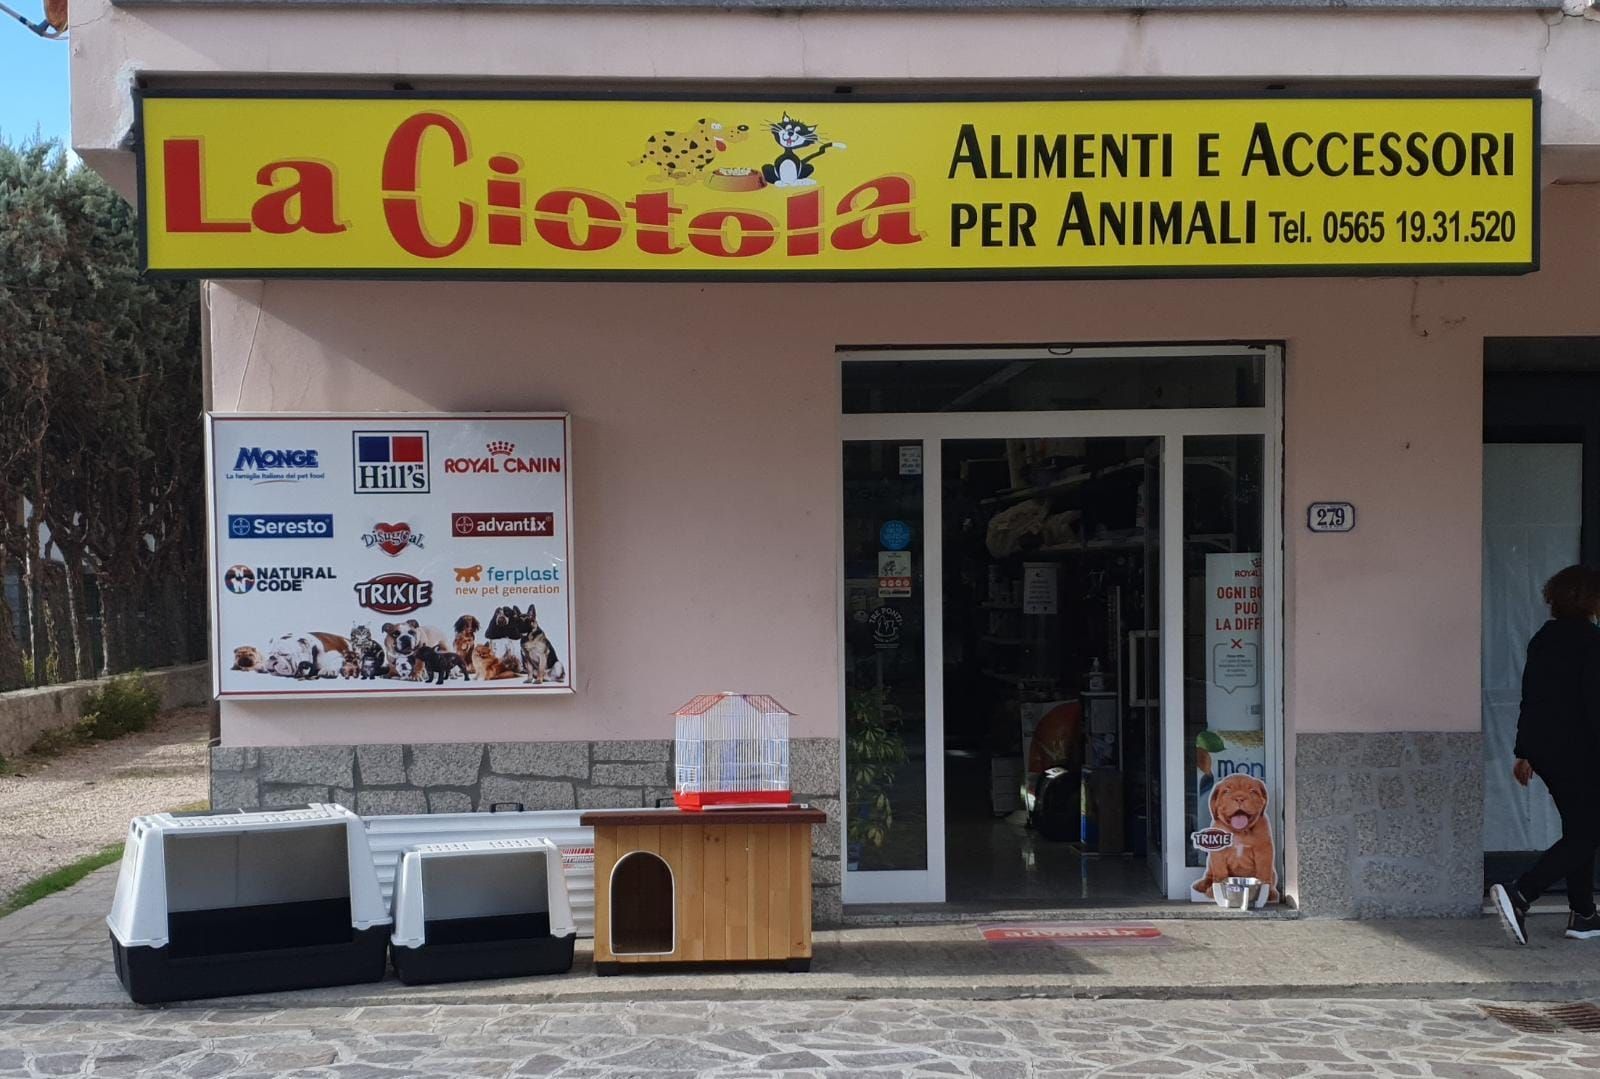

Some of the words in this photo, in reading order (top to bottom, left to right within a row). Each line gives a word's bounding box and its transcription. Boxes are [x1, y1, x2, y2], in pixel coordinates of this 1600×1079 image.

[948, 123, 1173, 179] ALIMENTI
[1198, 132, 1220, 177] E
[1241, 122, 1515, 178] ACCESSORI
[163, 135, 353, 233] La
[381, 110, 927, 259] Ciotola
[951, 202, 1037, 248] PER
[1056, 191, 1256, 247] ANIMALI
[1268, 212, 1312, 244] Tel.
[1322, 211, 1385, 243] 0565
[1395, 210, 1516, 243] 19.31.520
[233, 447, 320, 470] MONGE
[444, 458, 497, 474] ROYAL
[503, 457, 561, 473] CANIN
[359, 464, 426, 489] Hill's
[477, 516, 547, 533] advantix
[1317, 508, 1346, 526] 279
[254, 518, 328, 535] Seresto
[257, 567, 337, 580] NATURAL
[486, 566, 559, 584] ferplast
[257, 580, 303, 592] CODE
[356, 582, 430, 605] TRIXIE
[456, 586, 478, 595] new
[482, 585, 500, 597] pet
[502, 585, 560, 597] generation
[1217, 587, 1246, 599] OGNI
[1235, 599, 1258, 614] PUÒ
[1216, 618, 1232, 630] LA
[1235, 618, 1263, 630] DIFF
[1194, 834, 1231, 846] TRIXIE
